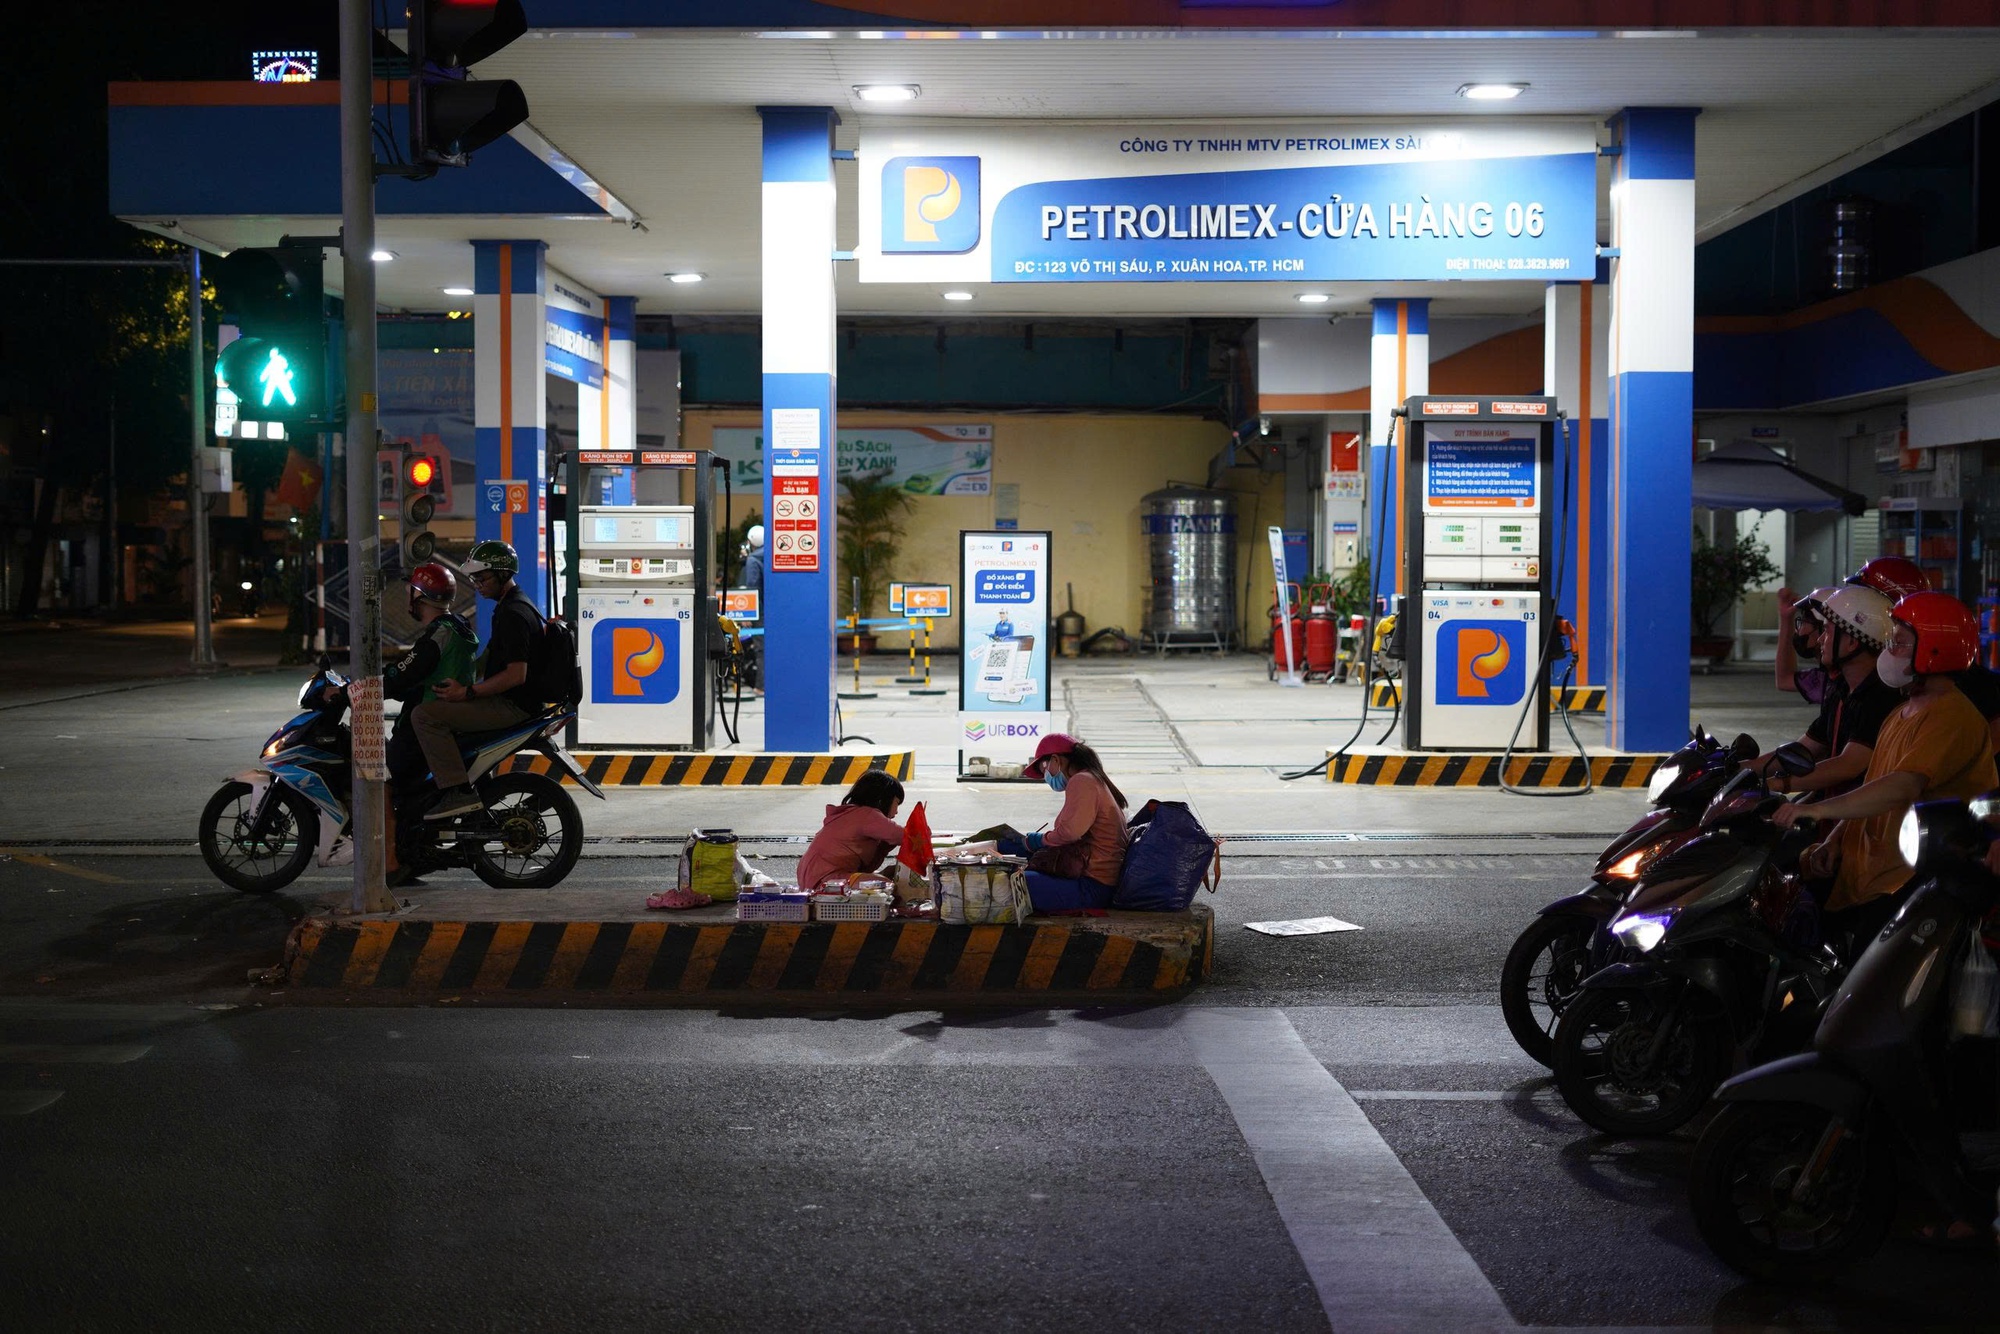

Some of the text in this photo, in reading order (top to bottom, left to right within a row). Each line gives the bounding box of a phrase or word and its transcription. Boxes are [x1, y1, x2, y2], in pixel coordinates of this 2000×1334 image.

[1120, 137, 1168, 153] CÔNG
[1173, 139, 1193, 152] TY
[1198, 139, 1242, 152] TNHH
[1247, 138, 1281, 152] MTV
[1285, 138, 1390, 151] PETROLIMEX
[1388, 192, 1494, 239] HÀNG
[1504, 201, 1545, 238] 06
[1070, 258, 1091, 273] VÕ
[1093, 260, 1117, 276] THỊ
[1119, 257, 1152, 274] SÁU,
[1156, 260, 1167, 273] P.
[1171, 257, 1210, 272] XUÂN
[1272, 259, 1304, 272] HCM
[1446, 258, 1470, 273] ĐIỆN
[855, 440, 892, 455] SẠCH
[856, 456, 897, 473] XANH
[1003, 592, 1020, 600] TOÁN
[582, 610, 594, 619] 06
[678, 611, 690, 620] 05
[1428, 611, 1441, 620] 04
[1523, 612, 1535, 621] 03
[988, 724, 1039, 737] URBOX
